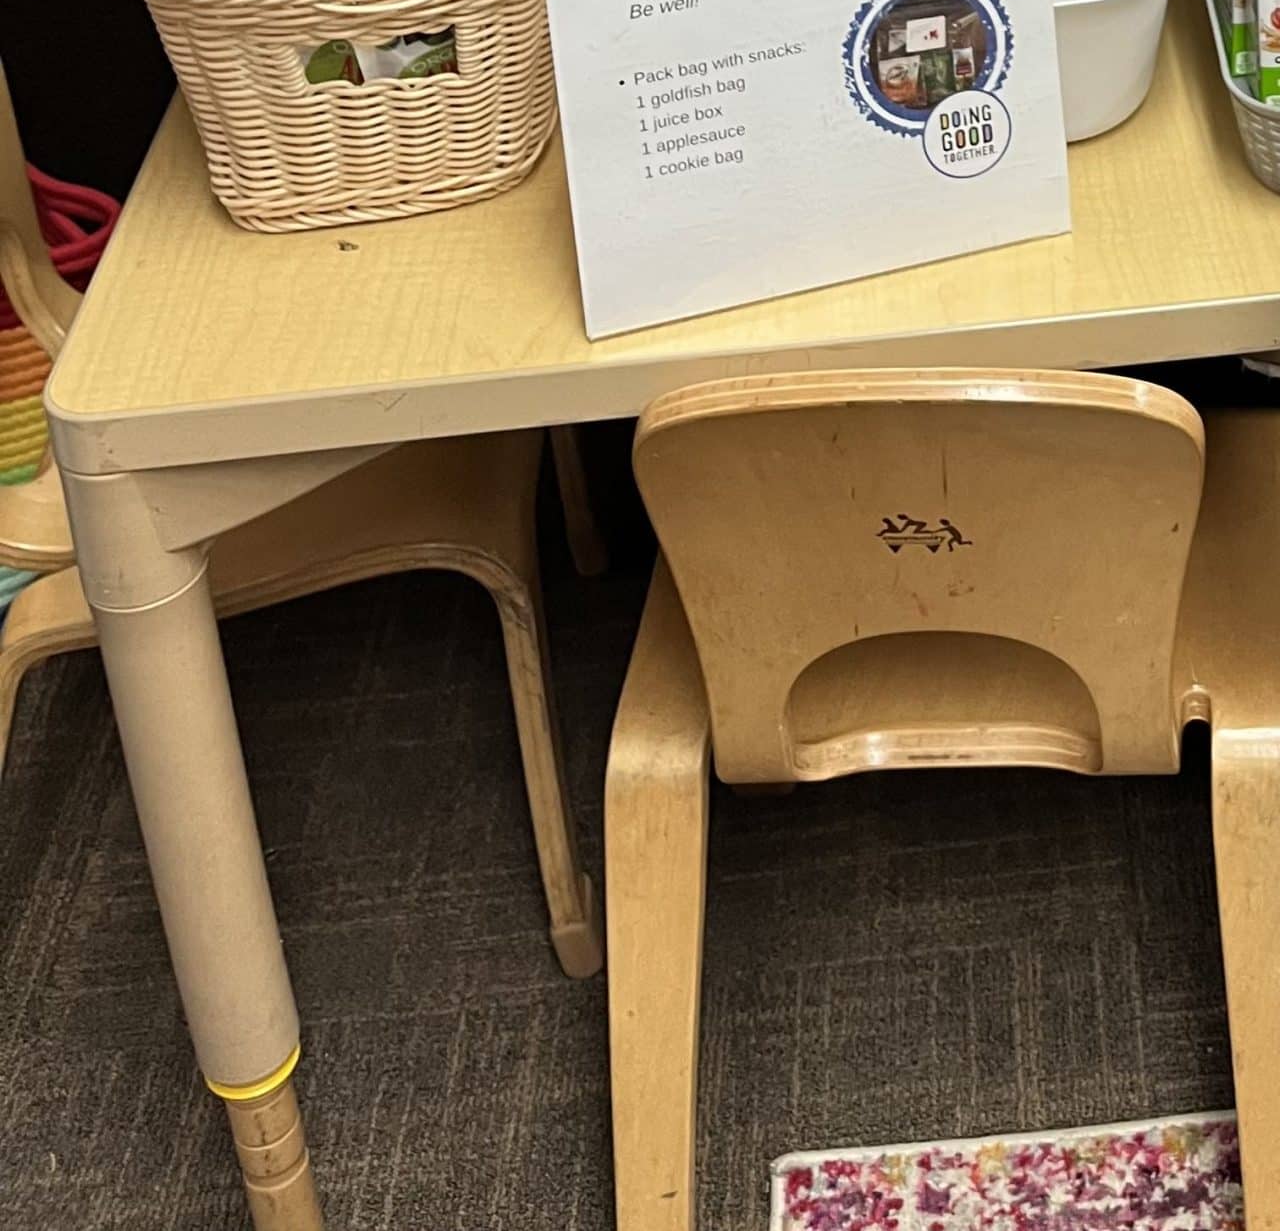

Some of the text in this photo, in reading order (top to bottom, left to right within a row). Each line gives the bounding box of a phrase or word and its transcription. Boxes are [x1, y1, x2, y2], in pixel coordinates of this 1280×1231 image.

[629, 3, 654, 20] Be
[633, 41, 807, 86] Pack bag with snacks:
[636, 77, 746, 109] 1 goldfish bag
[640, 105, 724, 133] 1 juice box
[642, 125, 746, 156] 1 applesauce
[942, 123, 993, 152] GOOD
[645, 149, 744, 180] 1 cookie bag
